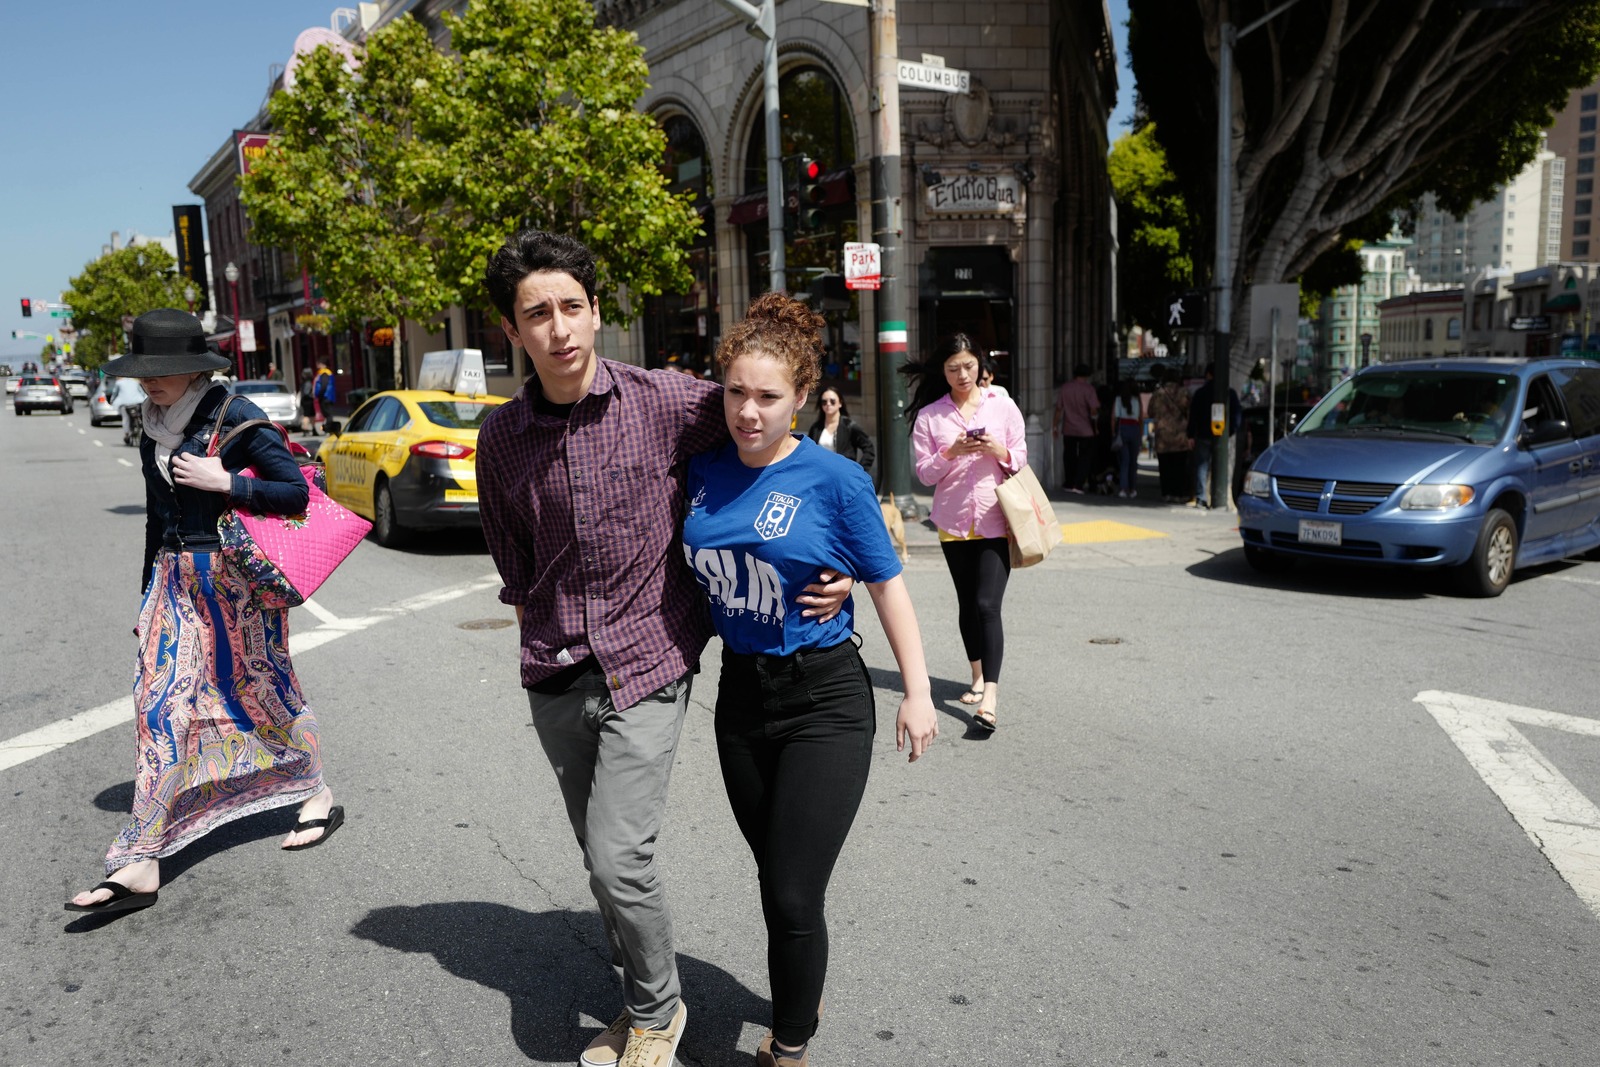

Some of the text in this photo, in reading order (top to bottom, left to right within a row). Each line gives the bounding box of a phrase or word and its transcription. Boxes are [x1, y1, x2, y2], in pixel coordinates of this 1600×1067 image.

[899, 65, 968, 90] COLUMBUS
[985, 175, 1016, 204] Qua
[851, 250, 876, 267] Park
[463, 370, 481, 378] TAXI
[772, 494, 795, 507] ITALIA
[1302, 527, 1339, 542] 7FNK094
